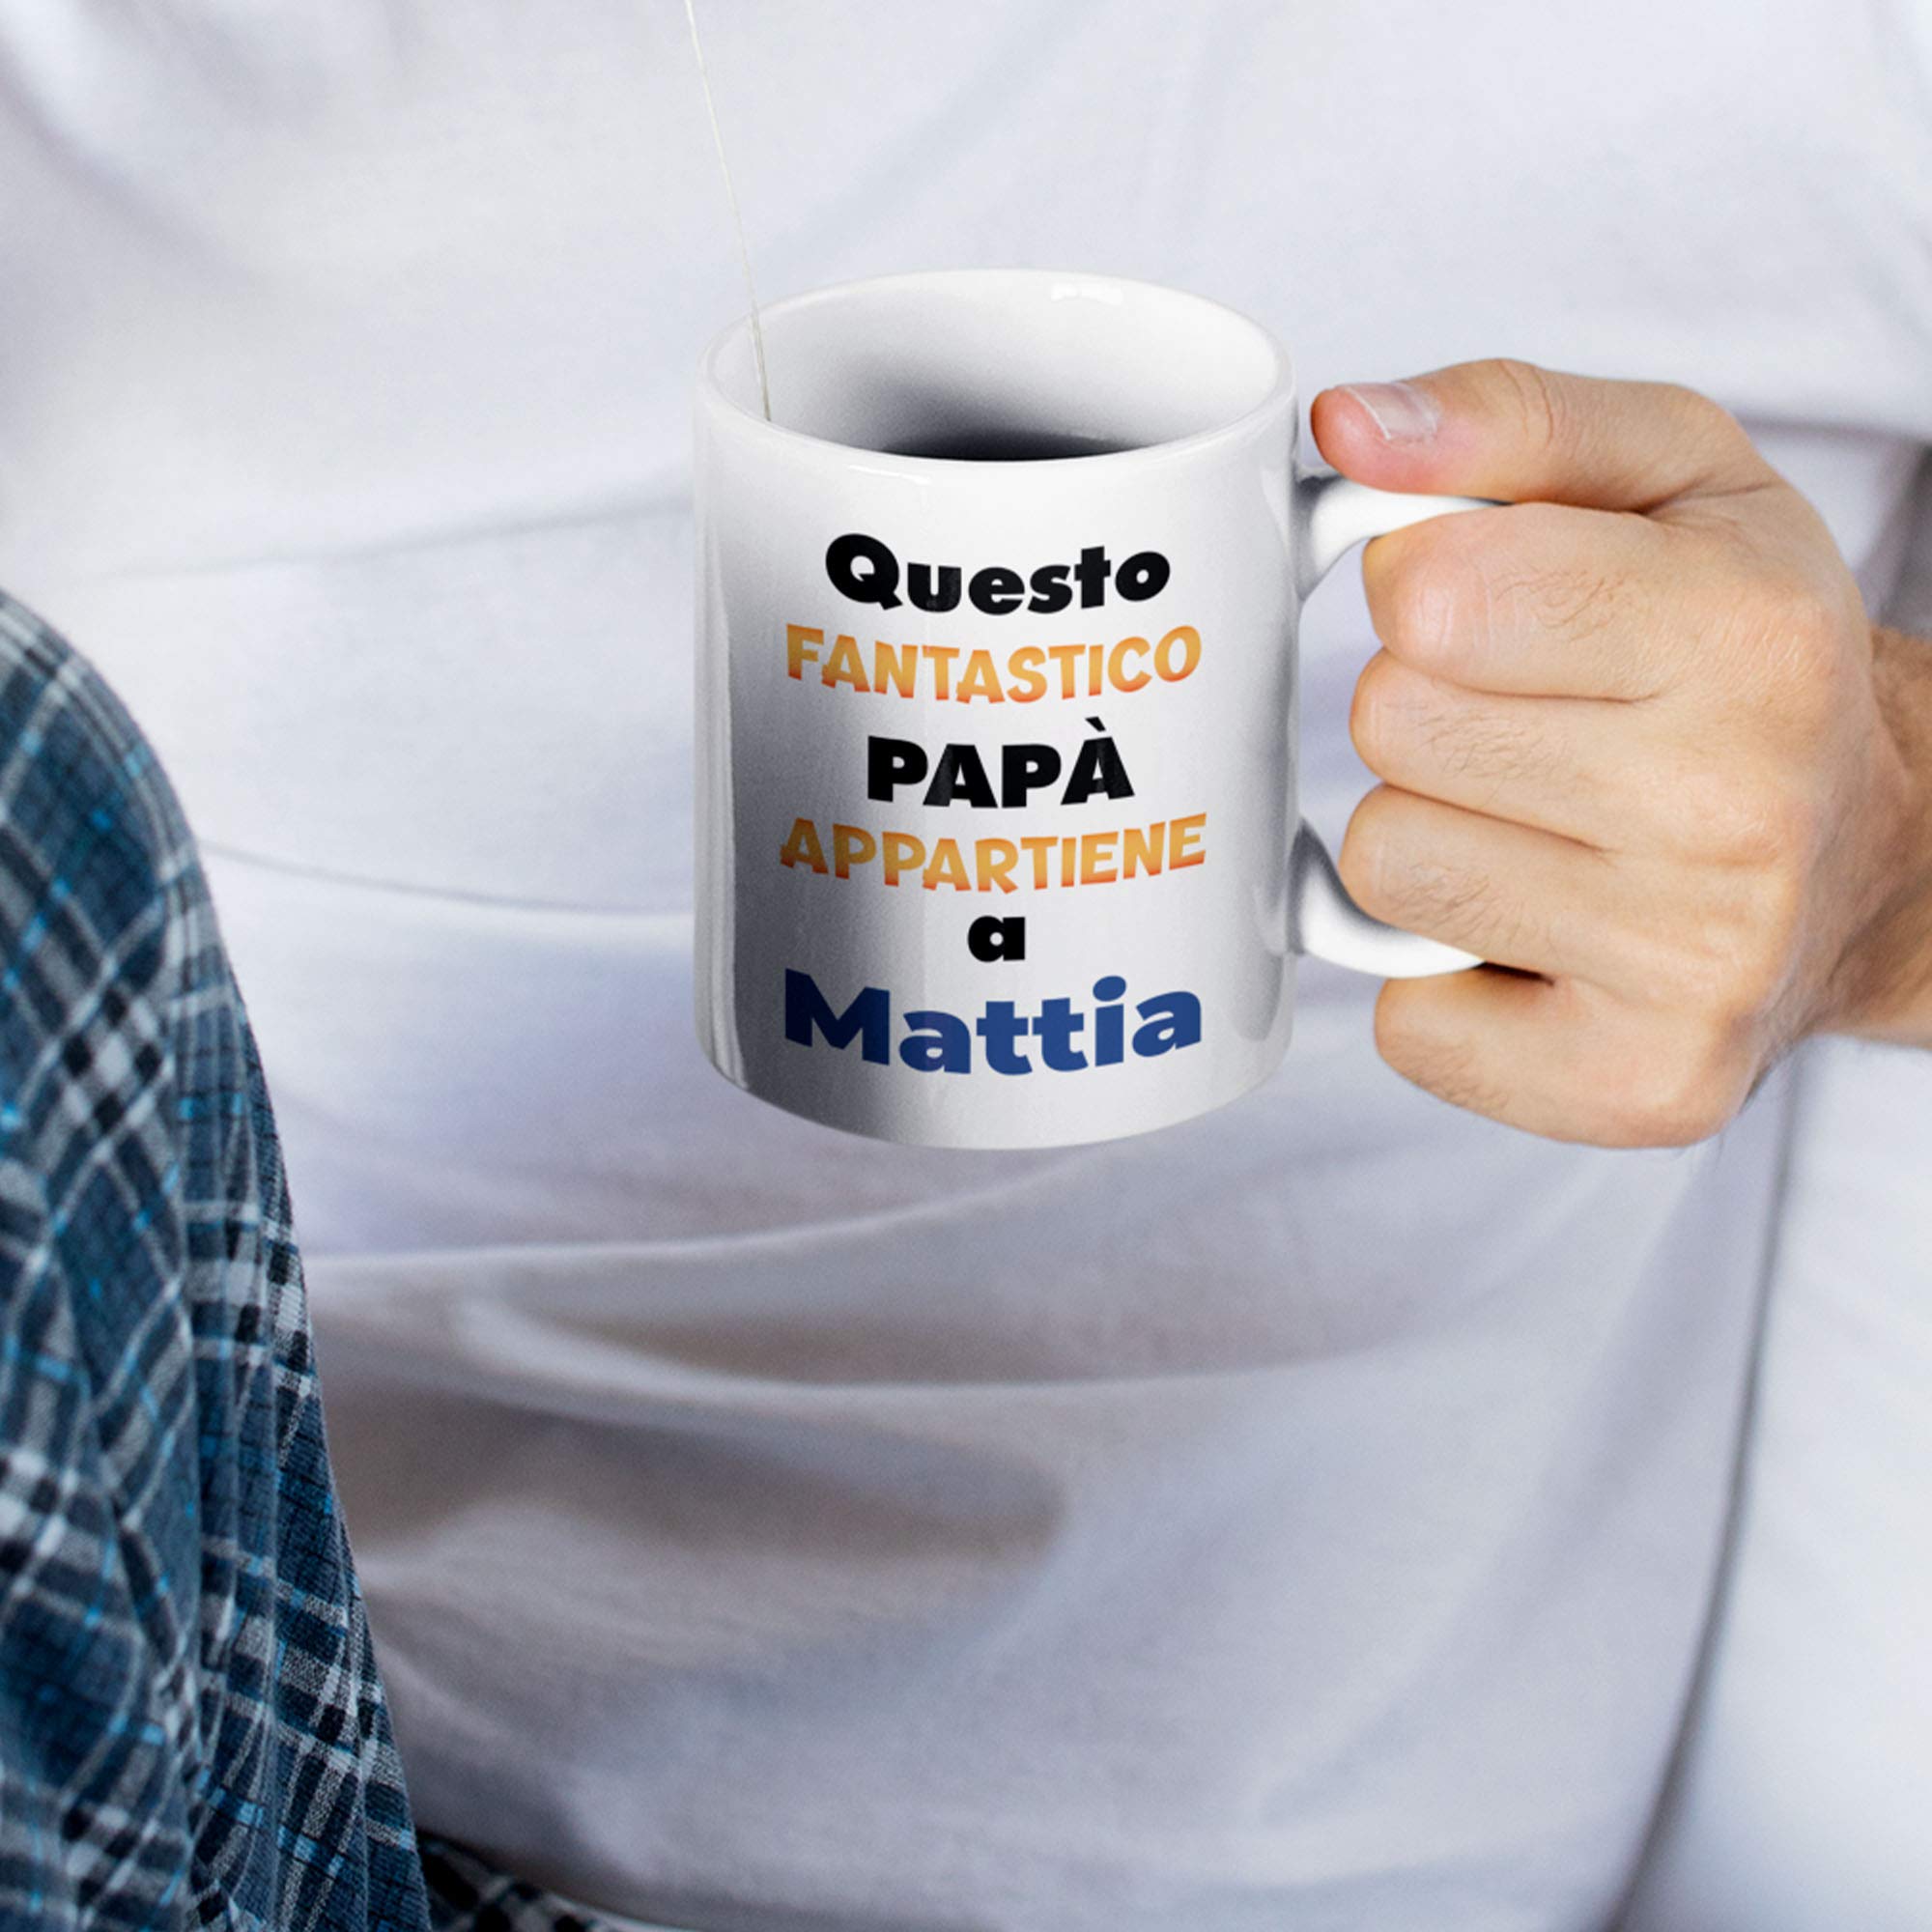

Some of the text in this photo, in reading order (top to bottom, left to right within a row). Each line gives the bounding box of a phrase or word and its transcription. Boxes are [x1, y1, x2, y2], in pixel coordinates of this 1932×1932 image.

[825, 532, 1171, 615] Questo
[785, 624, 1202, 704] FANTASTICO
[867, 716, 1135, 809] PAPÀ
[780, 812, 1207, 894] APPARTIENE
[967, 915, 1026, 963] a
[784, 968, 1202, 1075] Mattia
